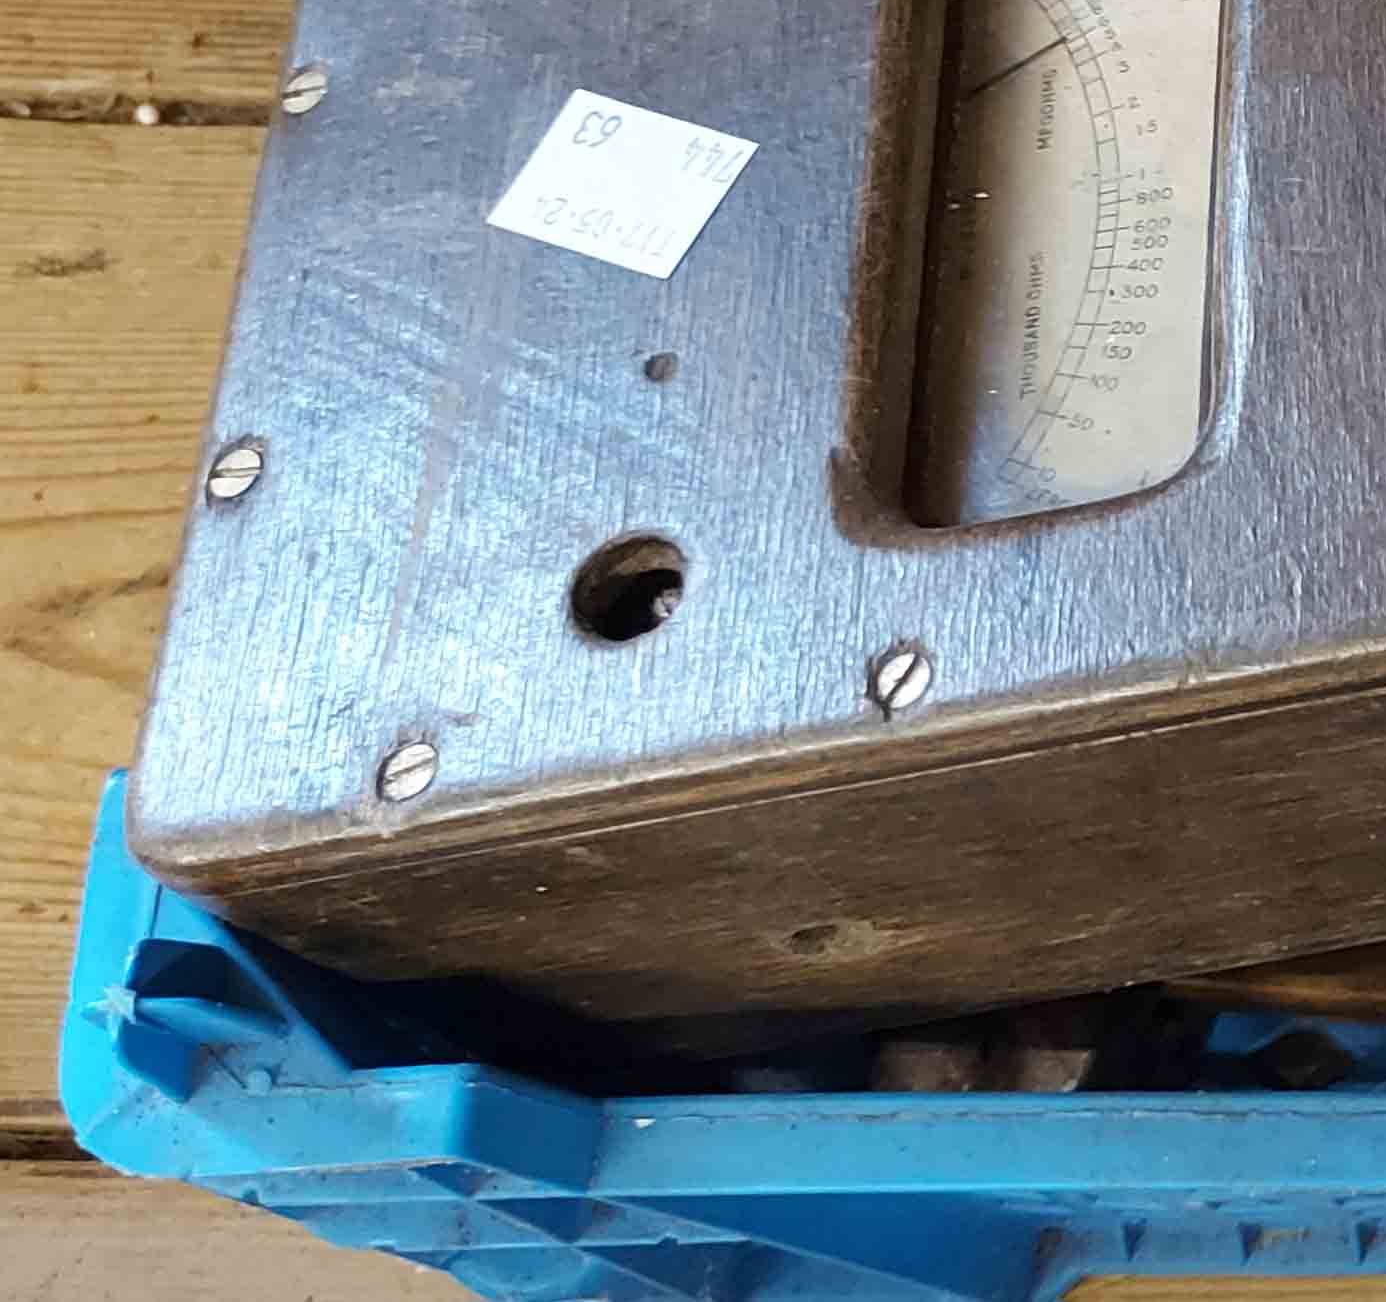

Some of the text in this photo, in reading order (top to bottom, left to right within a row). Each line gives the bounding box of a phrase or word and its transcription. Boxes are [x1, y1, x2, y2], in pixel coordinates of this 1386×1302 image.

[572, 111, 623, 148] 63
[1120, 283, 1160, 299] 300
[1108, 320, 1148, 336] 200
